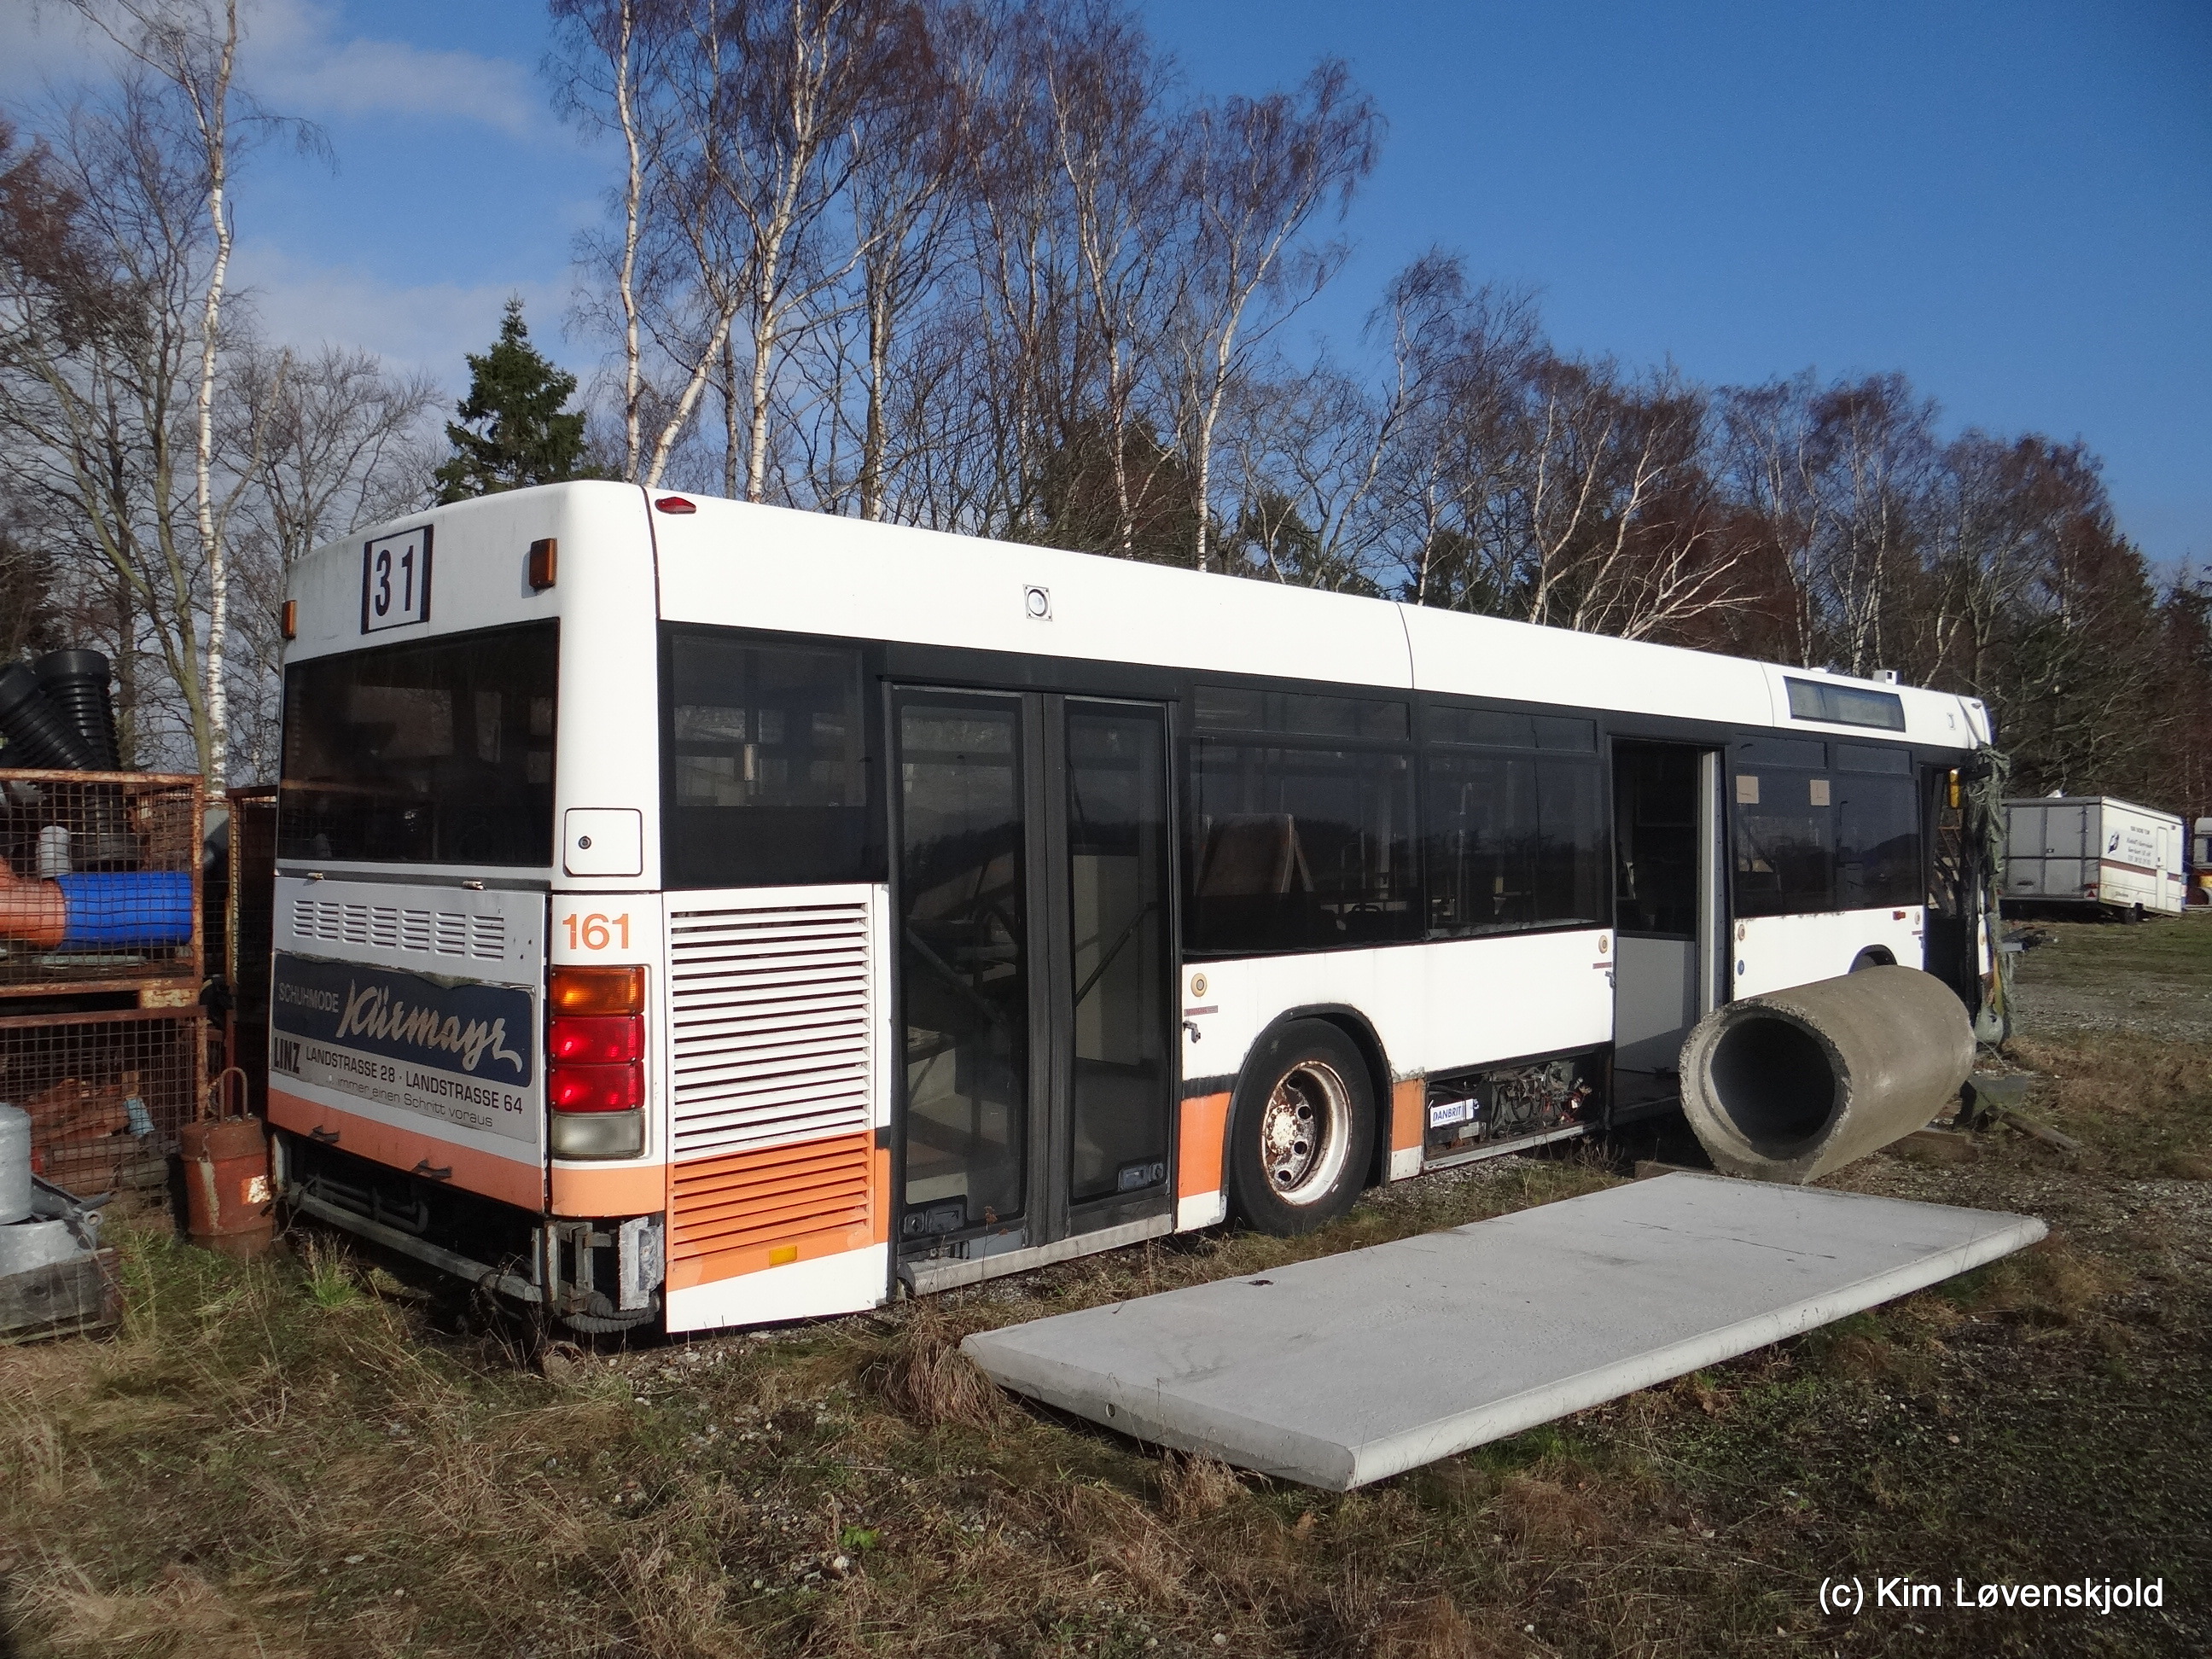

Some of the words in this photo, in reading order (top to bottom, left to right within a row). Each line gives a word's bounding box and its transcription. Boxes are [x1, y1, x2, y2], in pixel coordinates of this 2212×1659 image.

[375, 544, 414, 617] 31
[562, 912, 629, 951] 161
[278, 981, 340, 1014] SCHUHMODE
[273, 1035, 301, 1074] LINZ
[306, 1045, 377, 1079] LANDSTRASSE
[381, 1064, 395, 1084] 28
[405, 1070, 500, 1109] LANDSTRASSE
[504, 1093, 523, 1115] 64
[372, 1086, 400, 1103] einen
[404, 1092, 445, 1115] Schritt
[448, 1107, 493, 1127] voraus
[1433, 1105, 1462, 1122] DANBRIT
